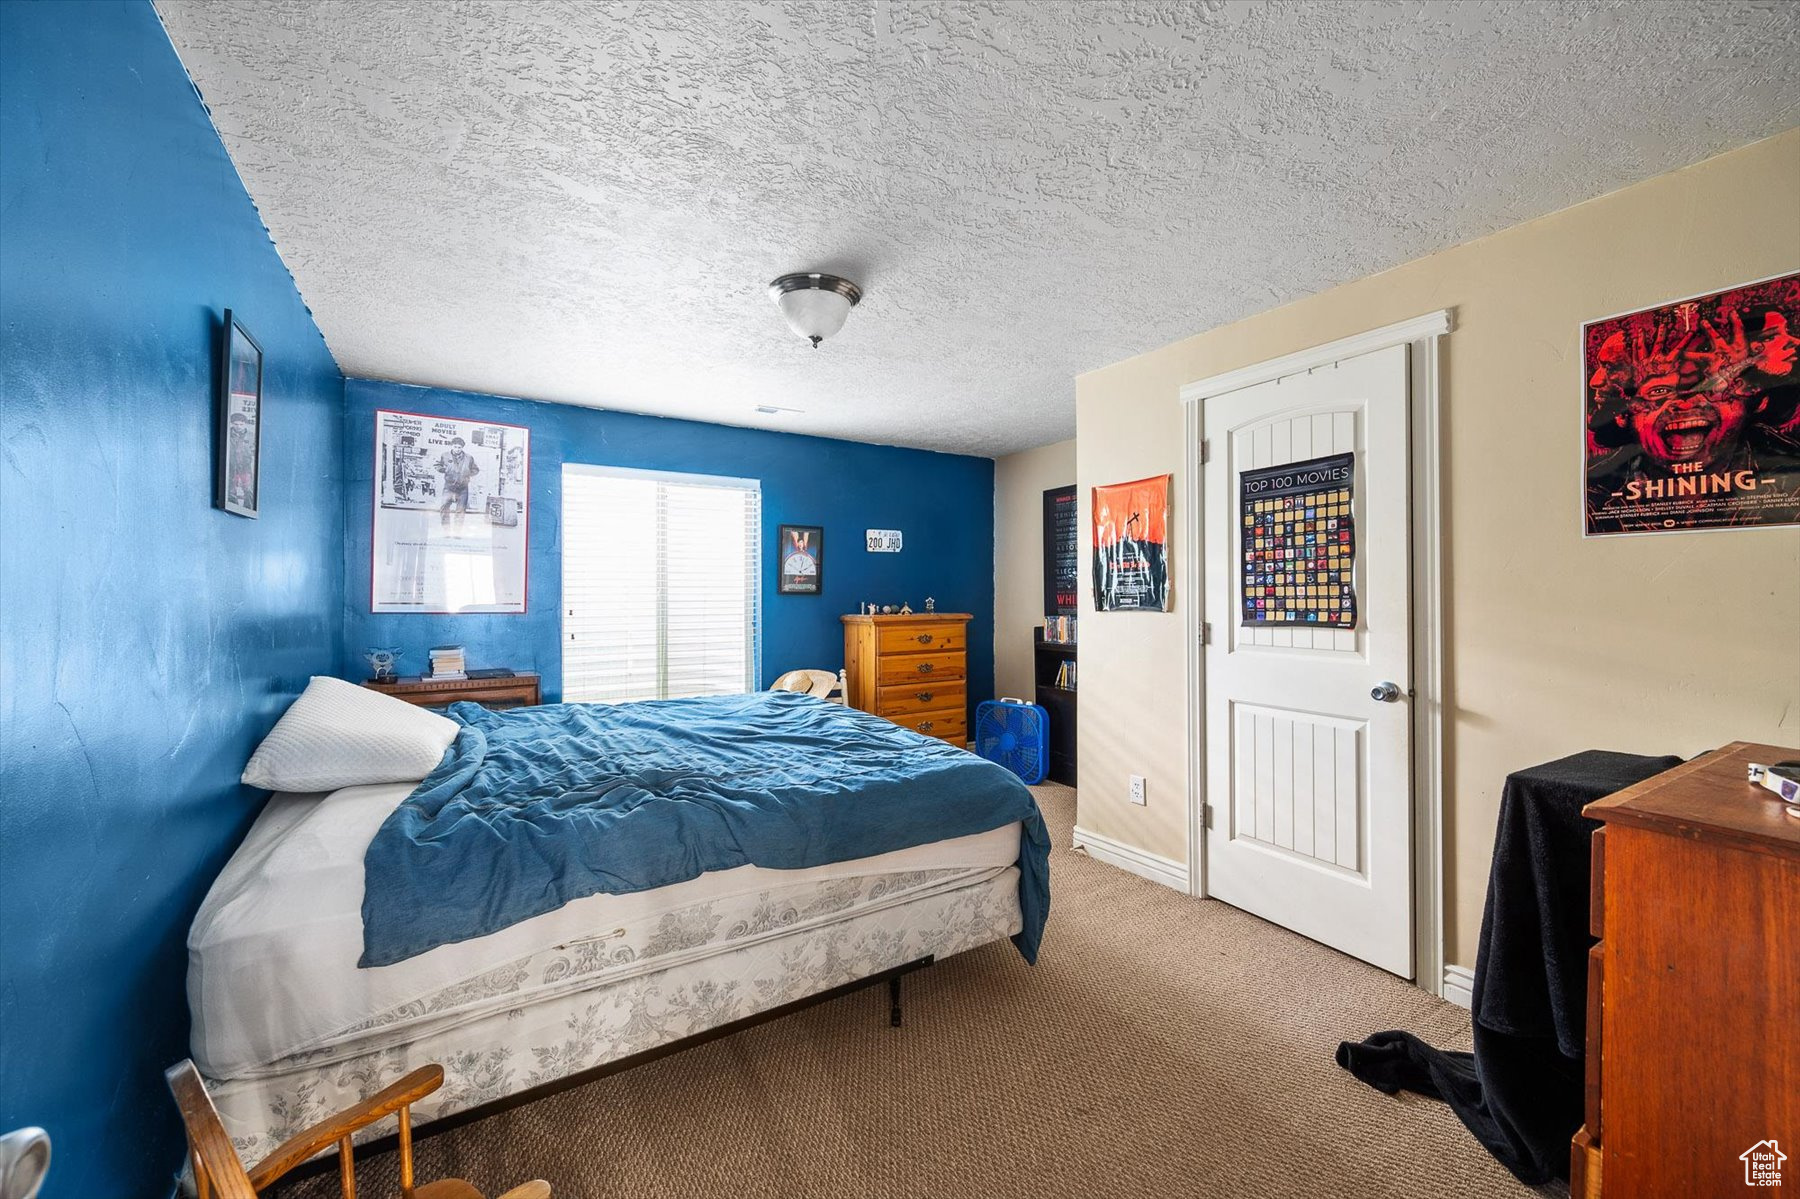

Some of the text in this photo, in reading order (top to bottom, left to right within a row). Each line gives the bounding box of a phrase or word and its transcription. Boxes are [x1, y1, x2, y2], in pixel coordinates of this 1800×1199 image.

[432, 428, 456, 436] MOVIES
[1672, 461, 1704, 474] THE
[1245, 467, 1350, 494] TOP 100 MOVIES
[1626, 470, 1756, 500] SHINING
[868, 537, 882, 548] 200
